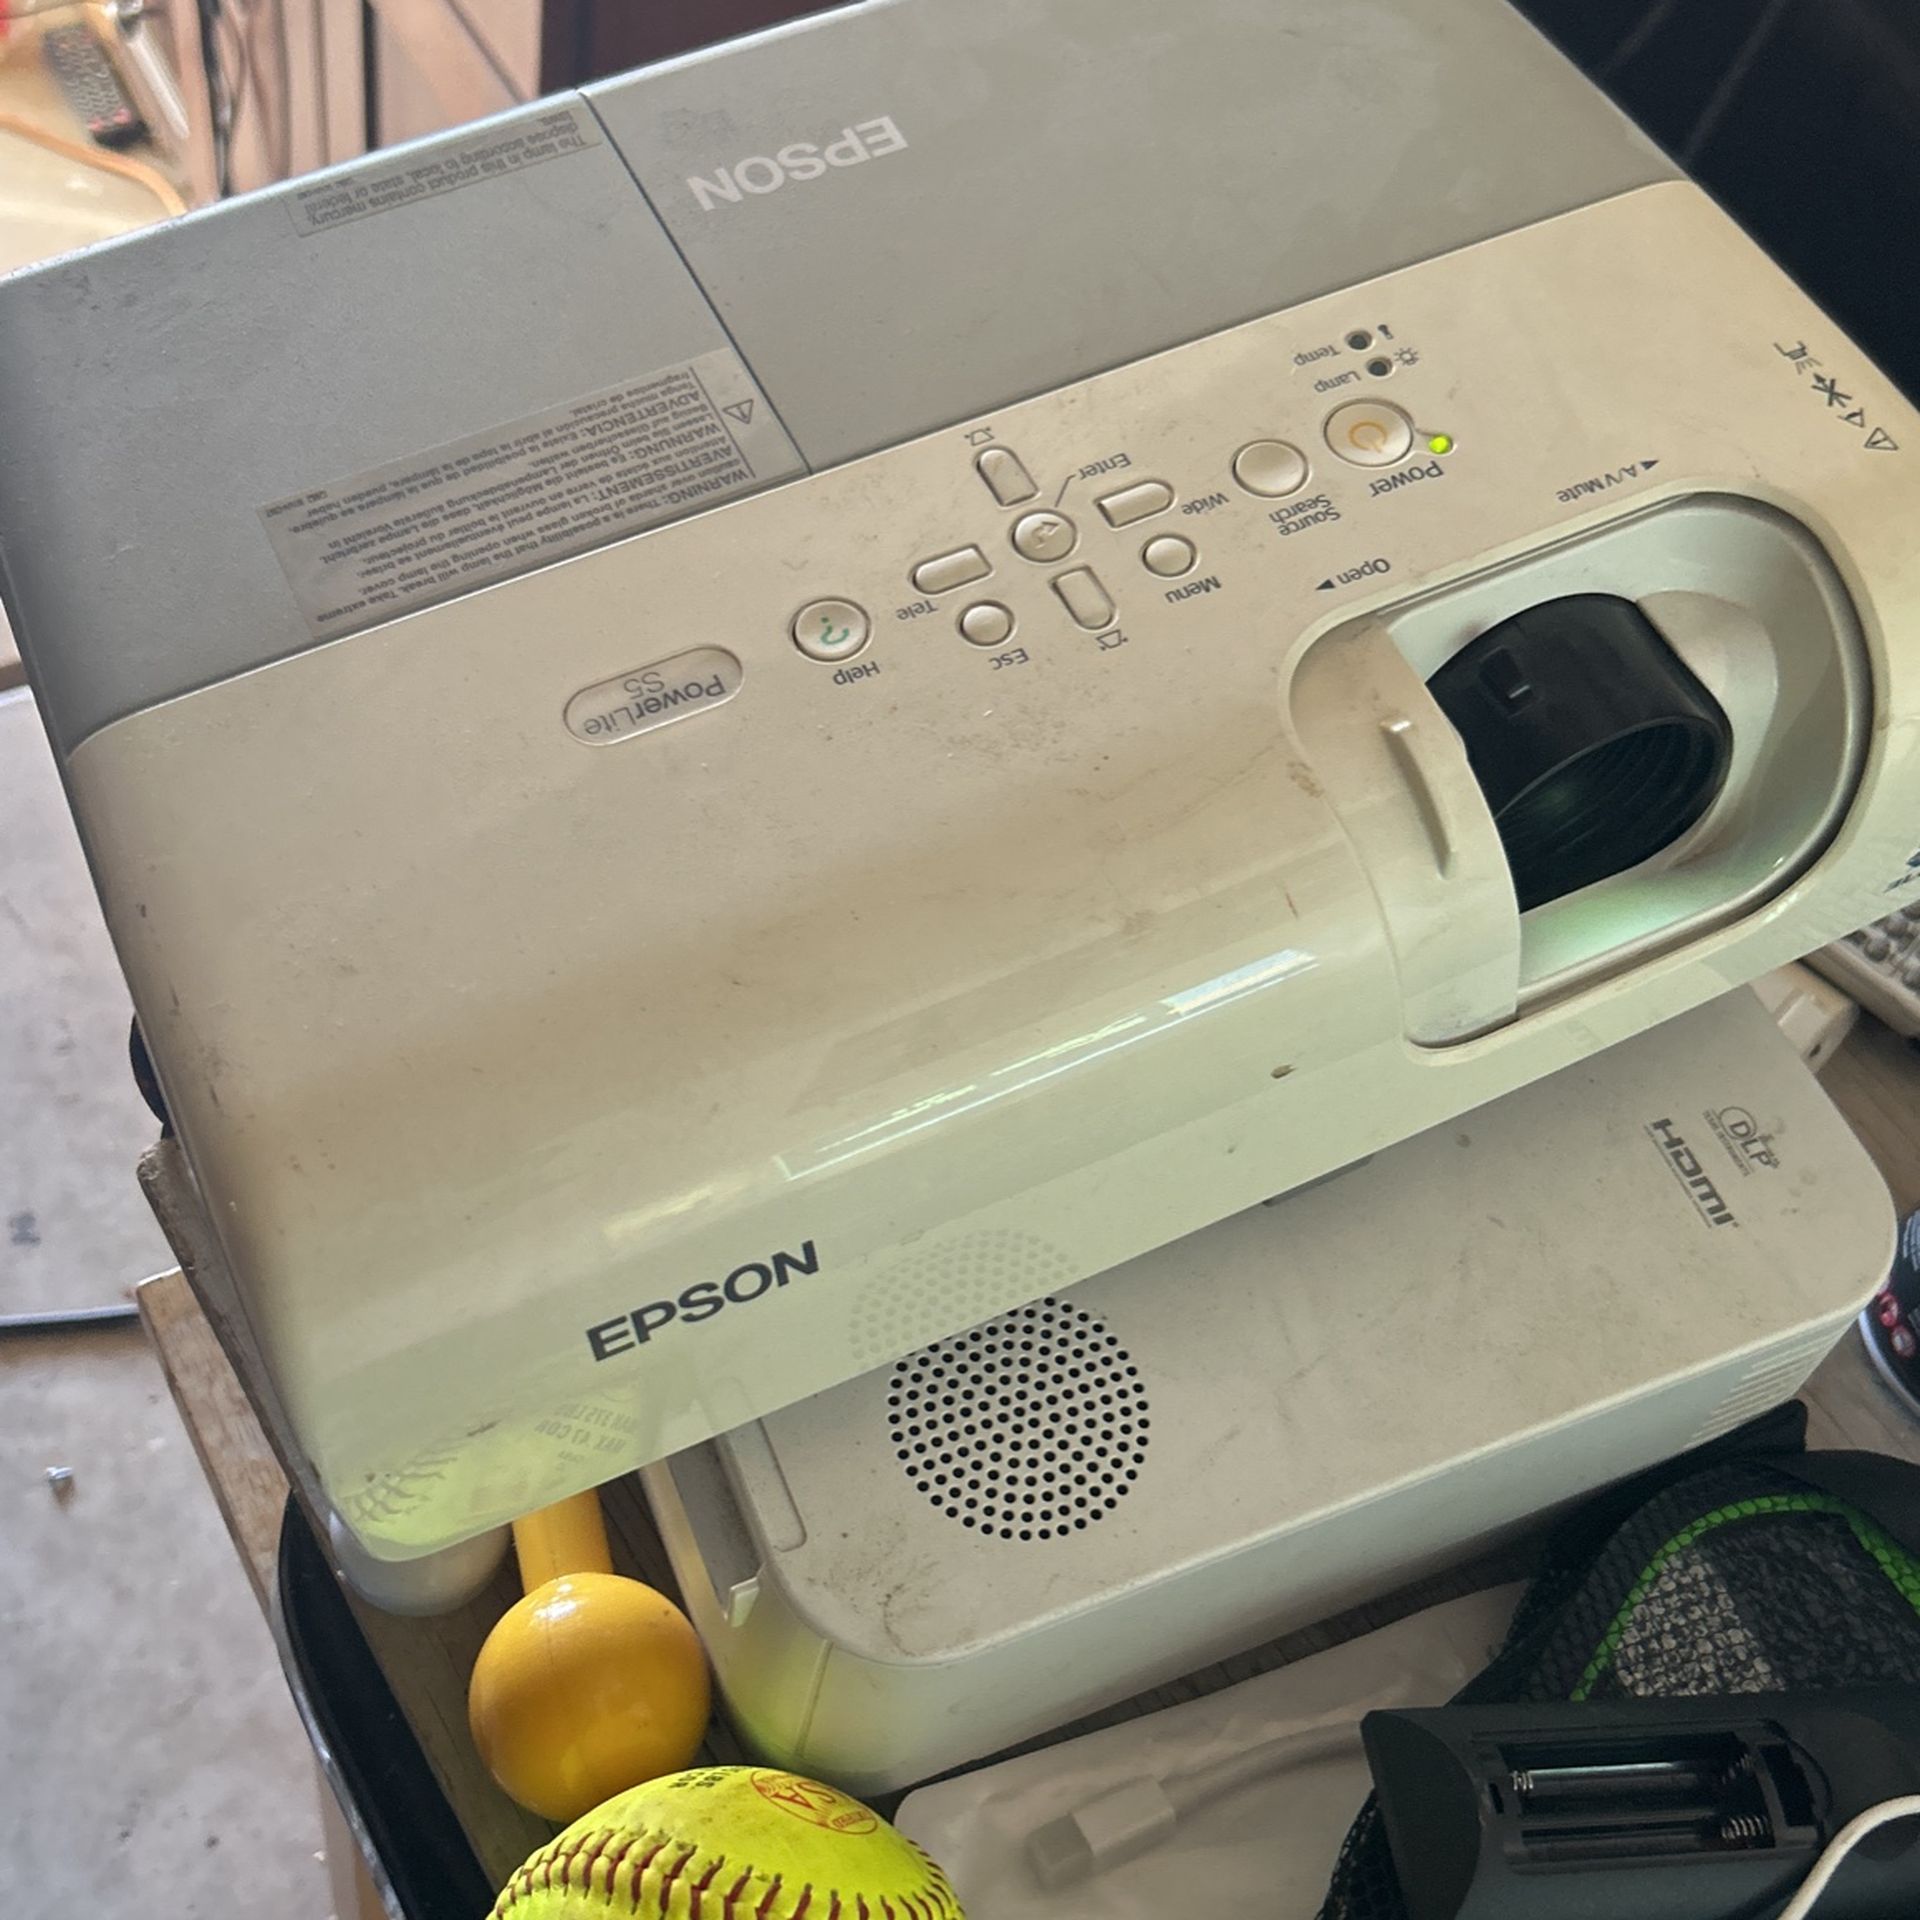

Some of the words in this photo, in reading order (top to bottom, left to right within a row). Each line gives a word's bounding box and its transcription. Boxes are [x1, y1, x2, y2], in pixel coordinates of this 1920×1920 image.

[686, 115, 910, 212] EPSON
[1293, 344, 1341, 366] Temp
[1314, 370, 1361, 393] Lamp
[577, 389, 702, 439] ADVERTENCIA:
[625, 421, 722, 461] WARNUNG:
[589, 444, 736, 502] AVERTISSEMENT:
[1079, 453, 1132, 480] Enter
[1369, 460, 1444, 497] Power
[659, 468, 749, 507] WARNING:
[1556, 474, 1604, 503] Mute
[1182, 492, 1230, 515] Wide
[1268, 493, 1332, 524] Search
[1279, 506, 1341, 537] Source
[1336, 557, 1391, 587] Open
[1165, 576, 1222, 604] Menu
[896, 600, 938, 621] Tele
[833, 661, 880, 686] Help
[989, 648, 1029, 671] Esc
[622, 671, 665, 698] S5
[583, 674, 727, 736] PowerLite
[1729, 1120, 1772, 1166] DLP
[1652, 1118, 1735, 1226] HDMI
[586, 1239, 820, 1362] EPSON
